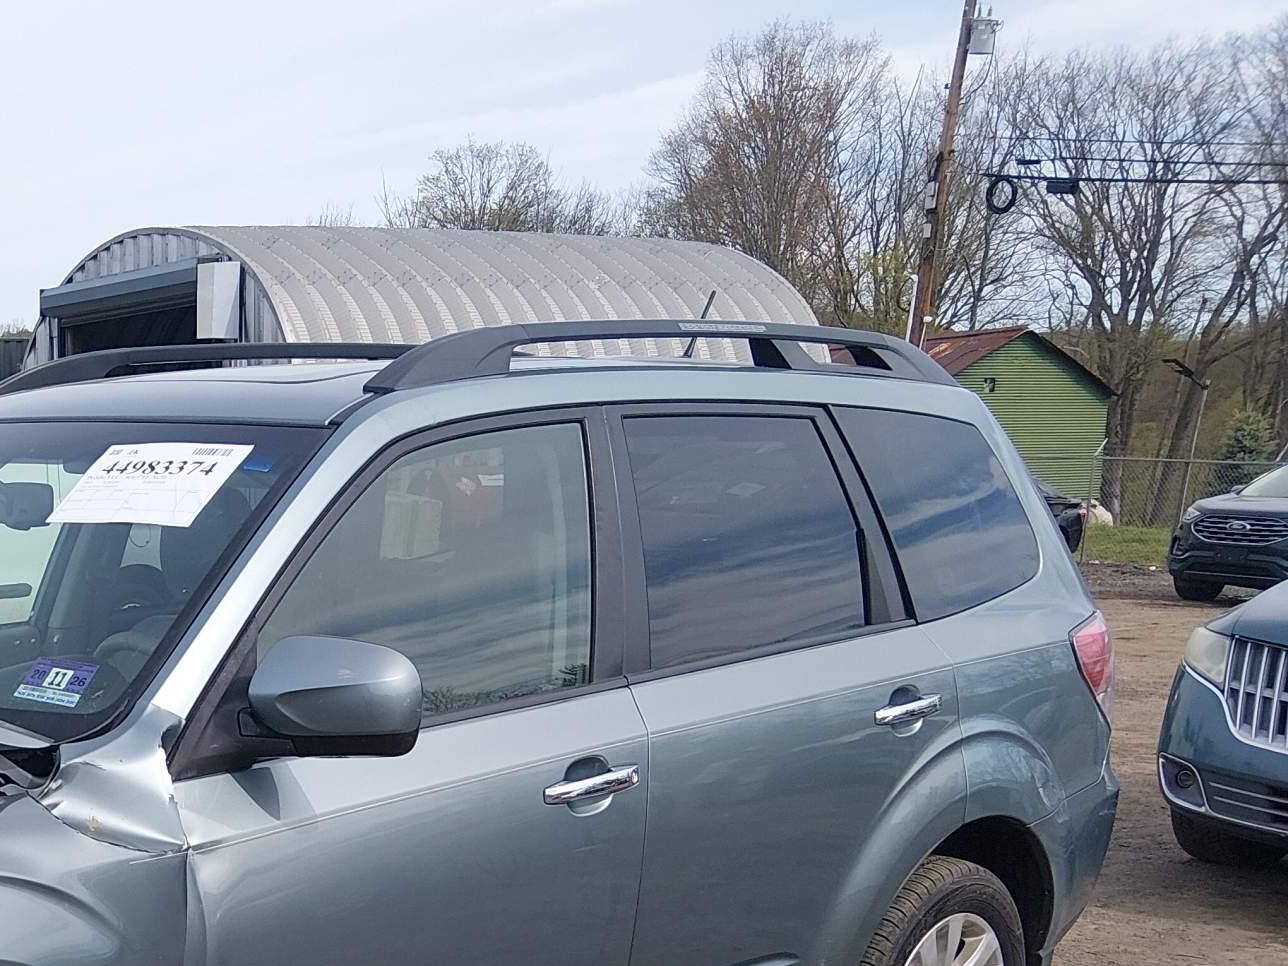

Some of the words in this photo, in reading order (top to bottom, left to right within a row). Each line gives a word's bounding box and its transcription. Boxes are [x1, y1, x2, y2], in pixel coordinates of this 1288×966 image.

[102, 460, 217, 476] 44983374
[30, 669, 47, 681] 20
[47, 671, 67, 687] 11
[69, 676, 88, 687] 26
